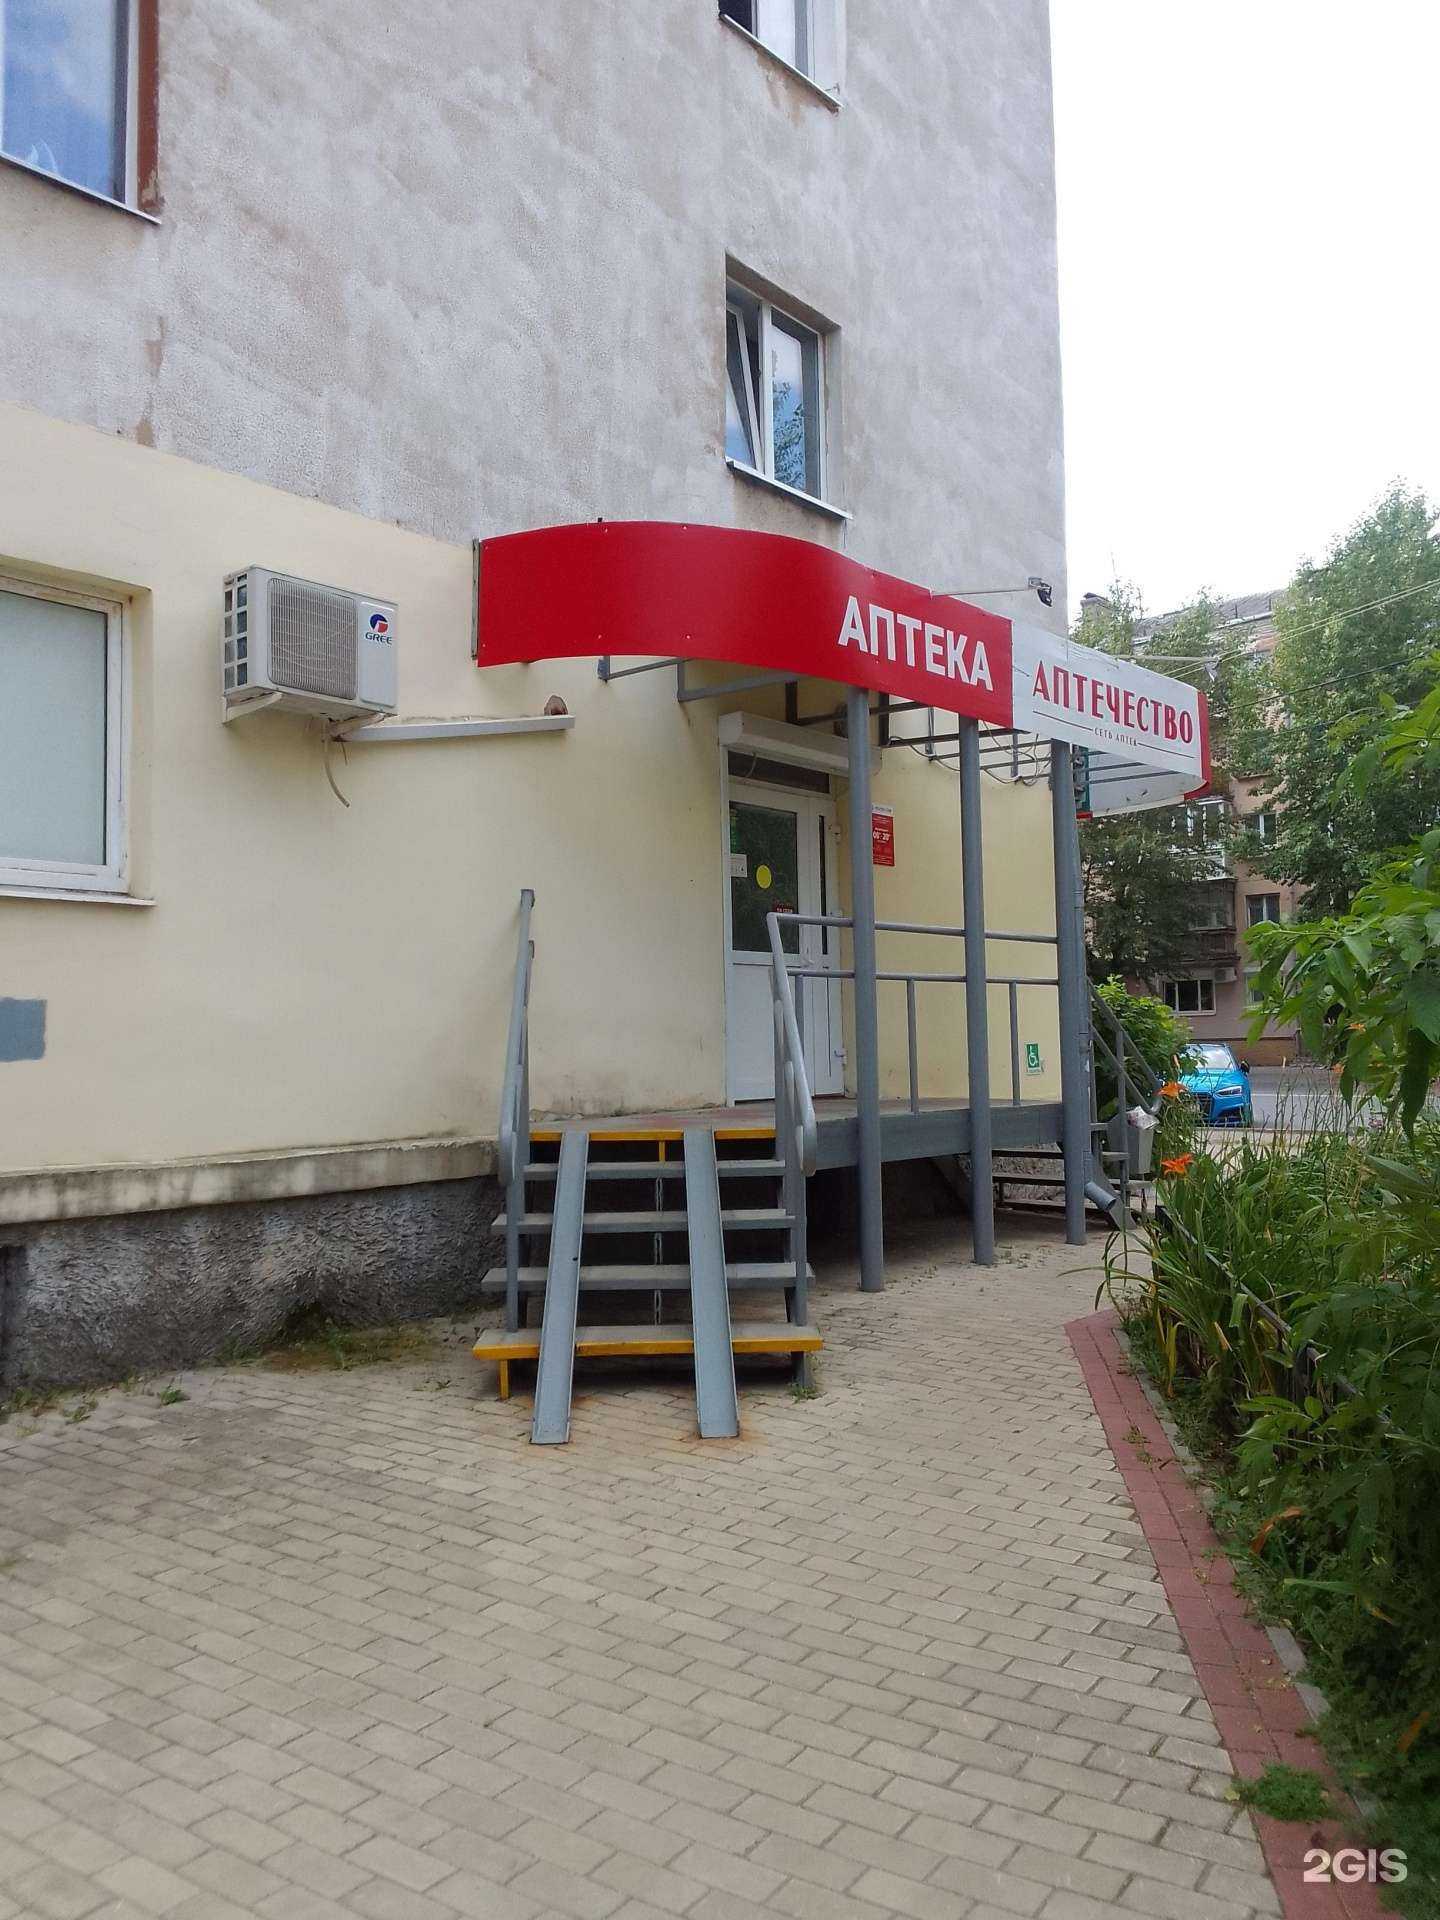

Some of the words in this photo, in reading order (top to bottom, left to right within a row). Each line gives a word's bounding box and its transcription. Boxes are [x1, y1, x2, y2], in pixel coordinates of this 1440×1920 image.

[365, 632, 393, 645] GREE
[838, 595, 994, 692] АПТЕКА
[1032, 660, 1193, 744] АПТЕЧЕСТВО
[1094, 727, 1113, 740] СЕТЬ
[1116, 733, 1138, 747] АПТЕК
